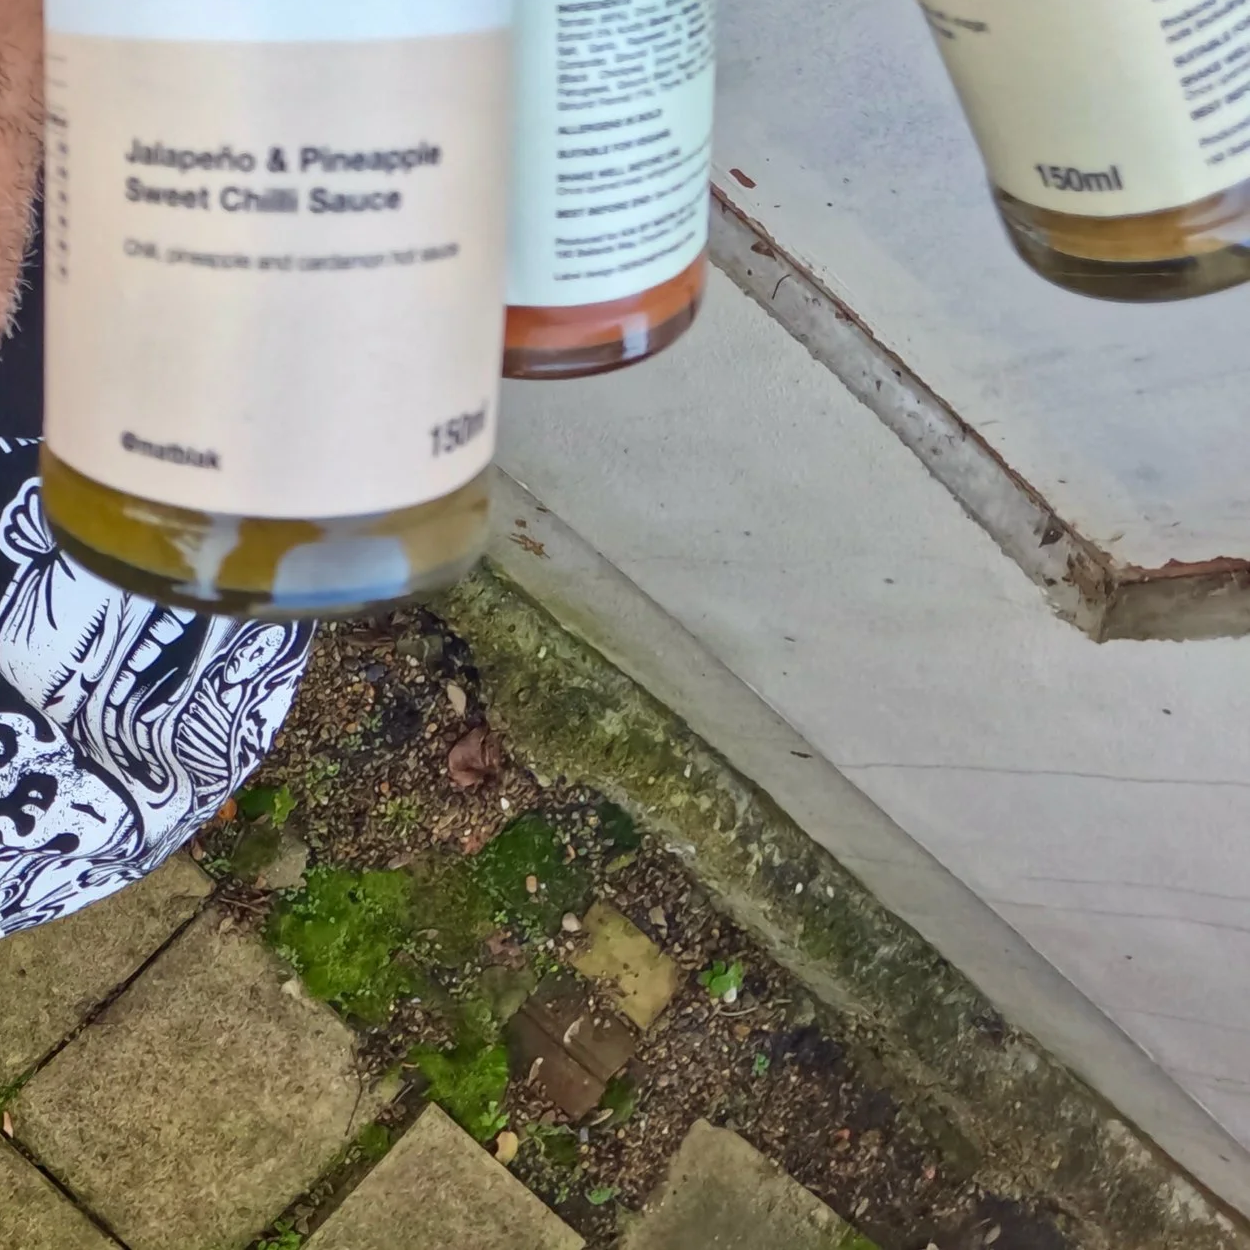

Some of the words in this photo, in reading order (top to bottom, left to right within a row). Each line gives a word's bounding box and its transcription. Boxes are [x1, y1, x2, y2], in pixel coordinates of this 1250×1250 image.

[265, 146, 288, 174] &
[1033, 162, 1124, 194] 150ml
[124, 175, 210, 210] Sweet
[308, 186, 403, 214] Sauce
